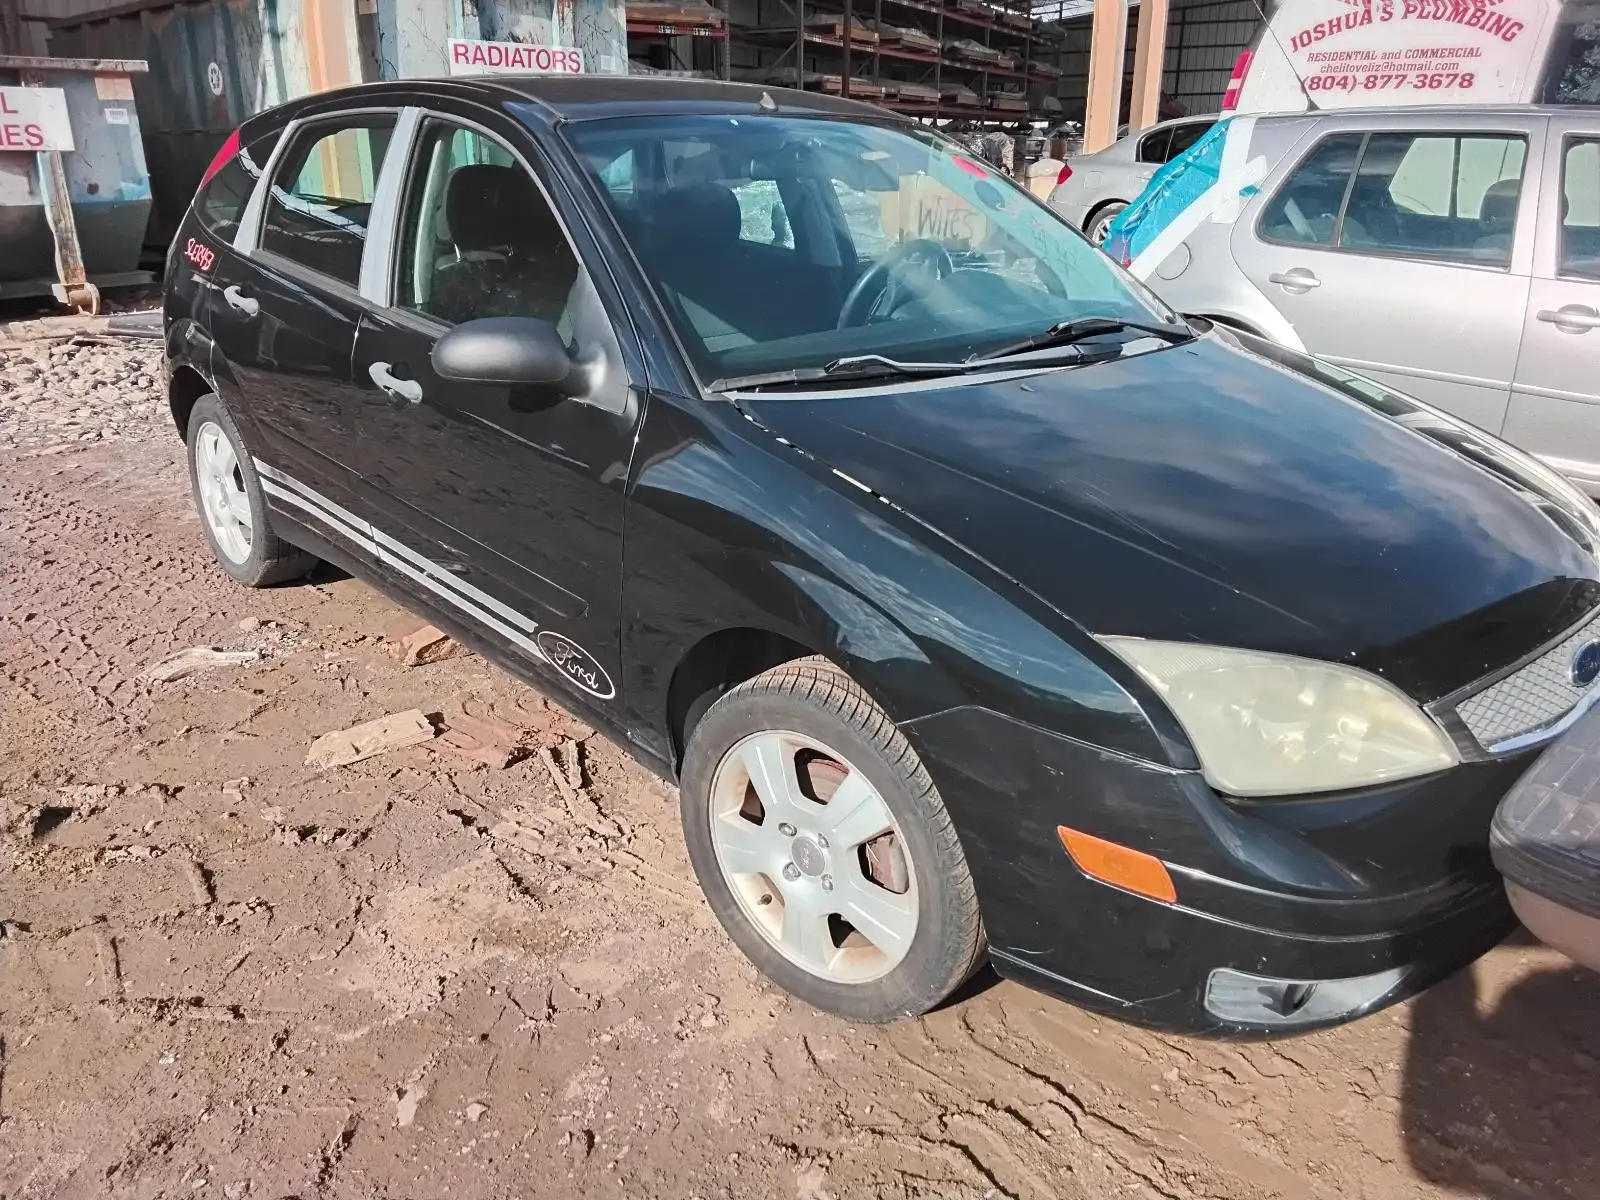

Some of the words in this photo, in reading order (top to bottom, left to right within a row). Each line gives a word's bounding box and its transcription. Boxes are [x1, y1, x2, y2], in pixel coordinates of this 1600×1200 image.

[1290, 5, 1394, 53] JOSHUA'S
[1401, 2, 1524, 42] PLUMBING
[453, 43, 581, 73] RADIATORS
[1306, 50, 1377, 62] RESIDENTIAL
[1380, 49, 1402, 60] and
[1405, 46, 1482, 59] COMMERCIAL
[554, 641, 599, 689] Ford
